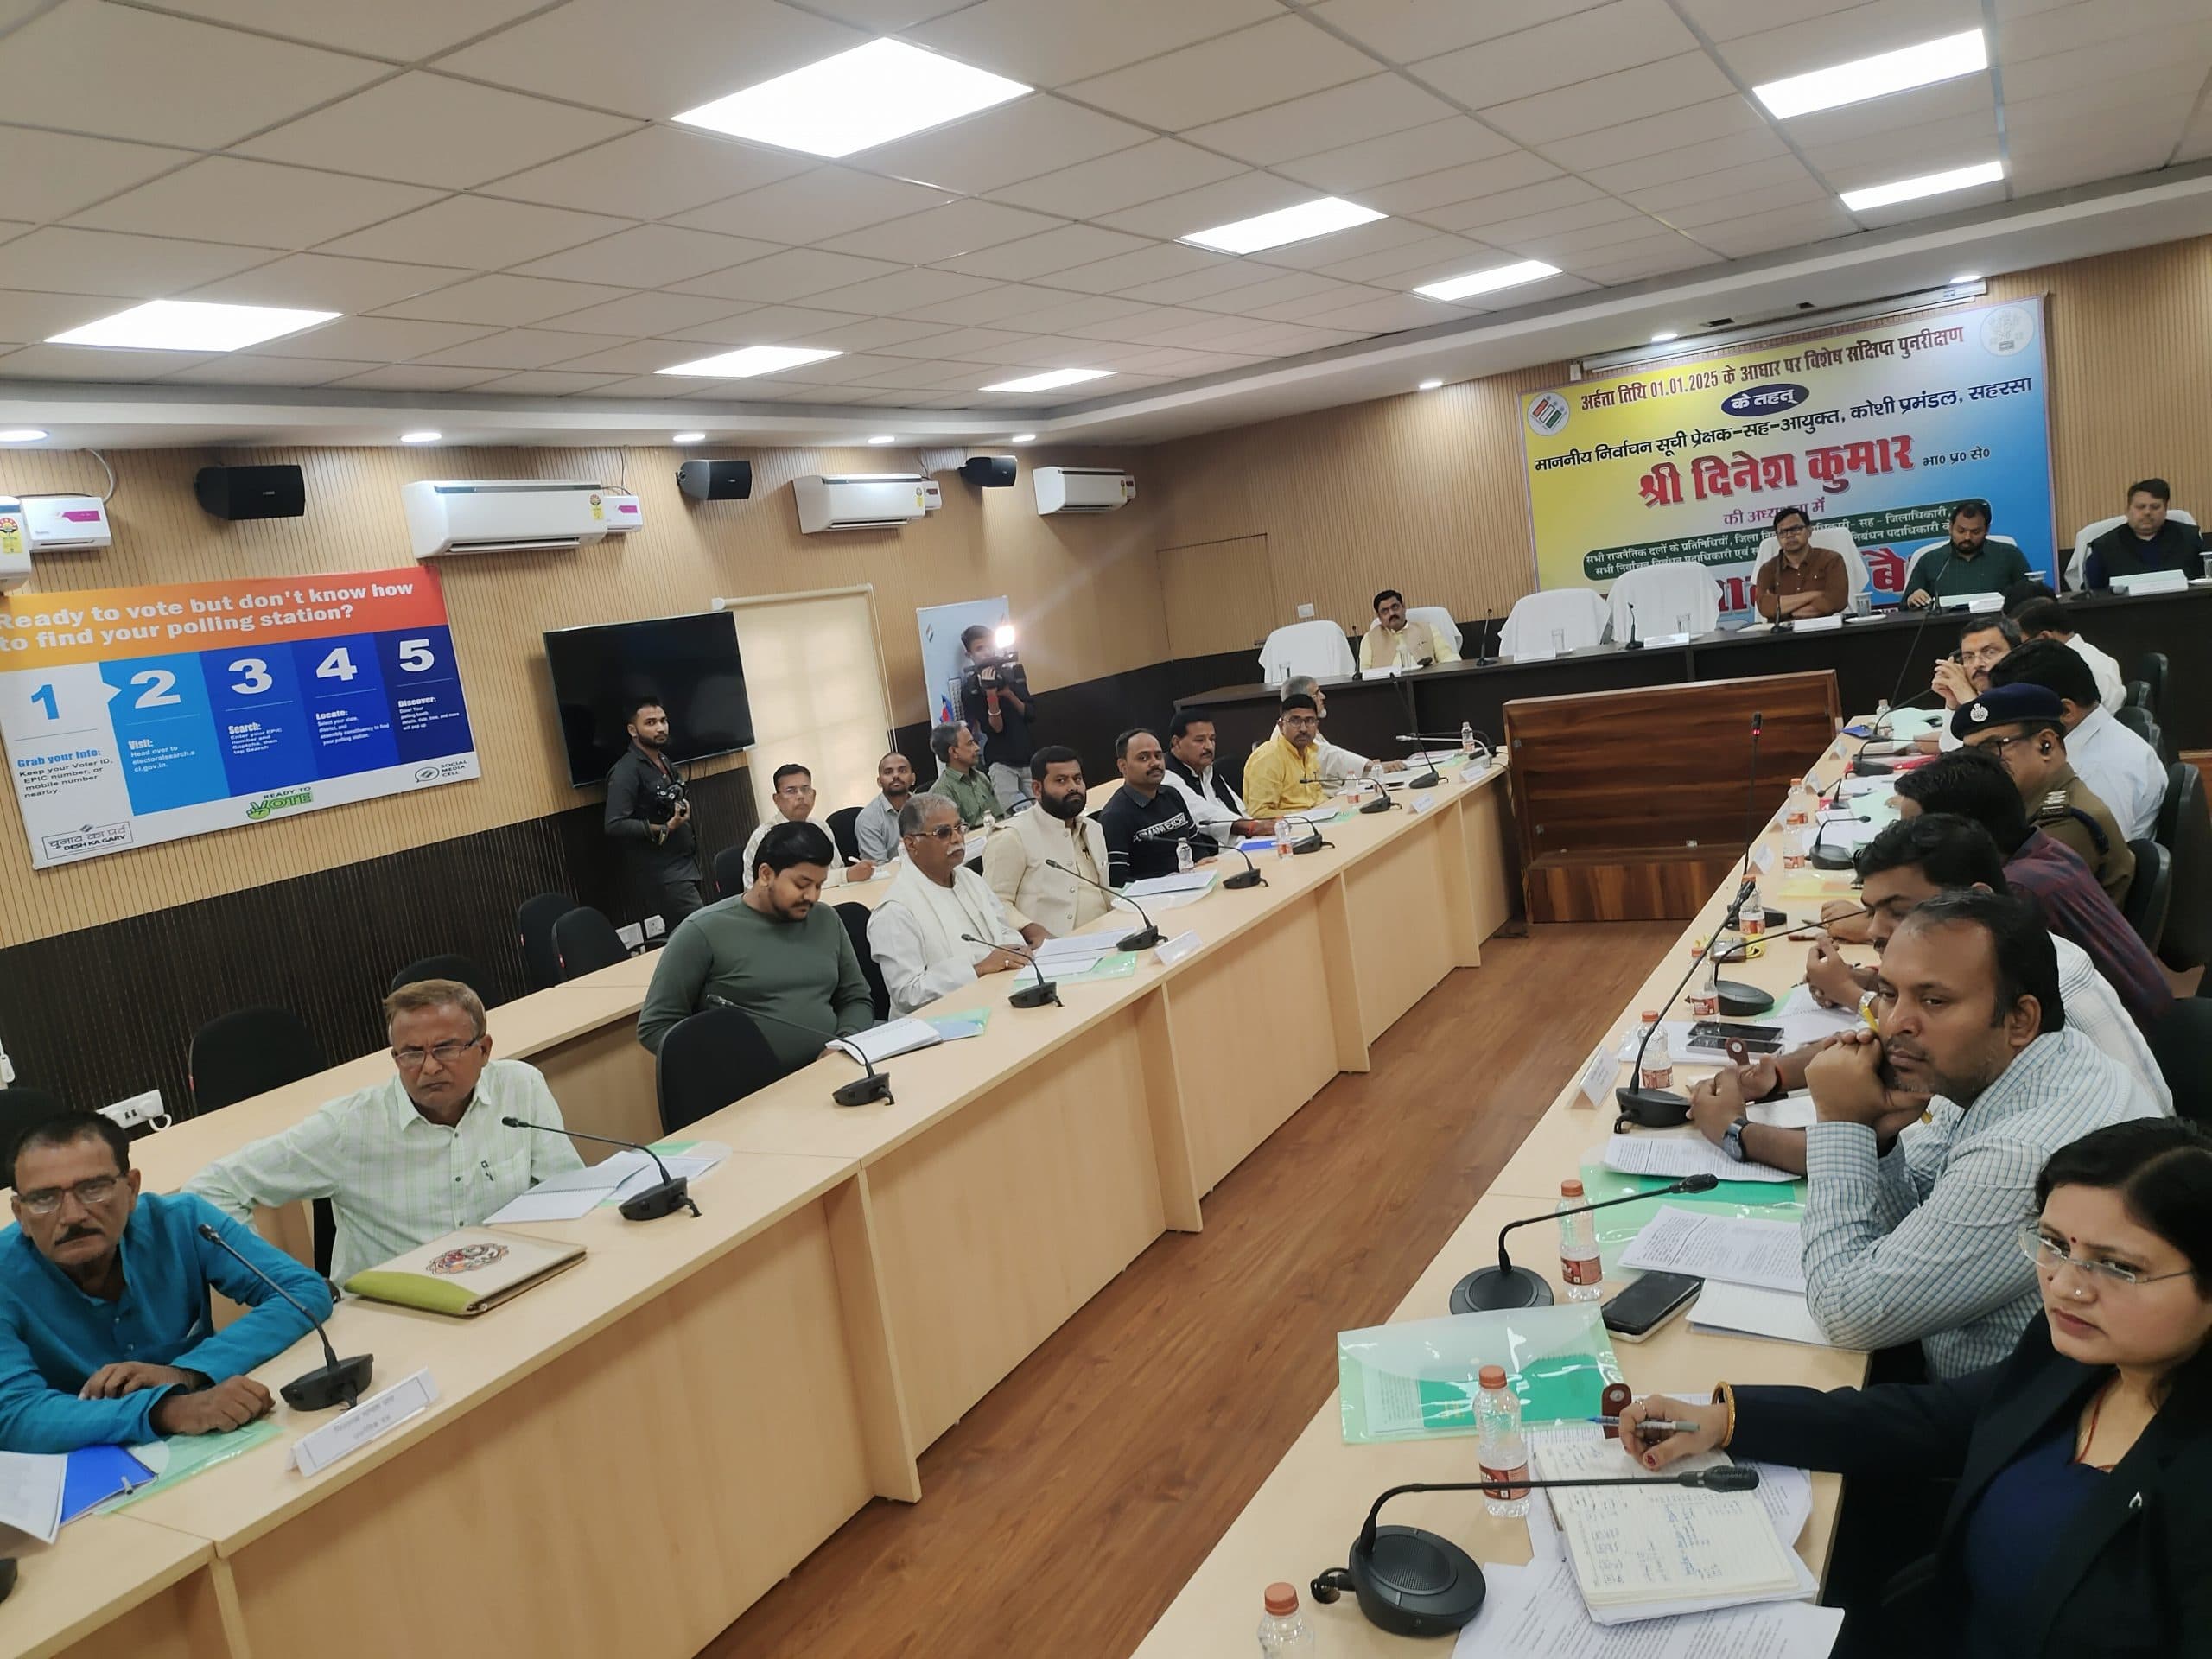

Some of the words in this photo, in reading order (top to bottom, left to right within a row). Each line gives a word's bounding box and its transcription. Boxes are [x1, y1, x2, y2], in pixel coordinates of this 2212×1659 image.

[1618, 382, 1647, 404] तिथि
[1650, 372, 1719, 397] 01.01.2025
[1720, 365, 1736, 385] के
[1783, 356, 1802, 373] पर
[1803, 347, 1843, 370] विशेष
[1898, 327, 1964, 359] पुनरीक्षण
[1731, 393, 1750, 410] के
[1535, 448, 1592, 472] माननीय
[1595, 440, 1652, 462] निर्वाचन
[1656, 430, 1688, 457] सूची
[1850, 395, 1895, 419] कोशी
[1898, 390, 1963, 415] प्रमंडल,
[1968, 378, 2032, 401] सहरसा
[1638, 461, 1684, 508] श्री
[1690, 449, 1799, 500] दिनेश
[1805, 434, 1915, 494] कुमार
[1724, 508, 1744, 525] की
[1811, 496, 1826, 512] में
[1586, 551, 1605, 564] सभी
[1606, 547, 1647, 561] राजनैतिक
[1648, 543, 1668, 557] दलों
[1669, 541, 1679, 552] के
[1734, 532, 1759, 545] जिला
[1858, 518, 1875, 528] सह
[1594, 563, 1615, 576] सभी
[1734, 545, 1750, 560] एवं
[1885, 520, 1940, 537] पदाधिकारी
[0, 608, 83, 630] Ready
[91, 607, 120, 622] to
[126, 601, 183, 620] vote
[189, 595, 234, 614] but
[238, 589, 305, 610] don't
[308, 588, 366, 604] know
[371, 582, 413, 598] how
[0, 636, 29, 652] to
[35, 628, 93, 648] find
[100, 624, 160, 645] your
[167, 614, 256, 639] polling
[259, 604, 353, 627] station?
[315, 647, 358, 682] 4
[398, 638, 435, 673] 5
[228, 658, 273, 695] 3
[130, 669, 181, 709] 2
[30, 683, 60, 721] 1
[398, 696, 436, 708] Discover:
[315, 710, 349, 721] Locate:
[228, 721, 262, 734] Search:
[128, 739, 154, 750] Visit:
[131, 749, 151, 758] Head
[17, 756, 45, 768] Grab
[48, 753, 73, 764] your
[75, 748, 101, 760] Info:
[19, 769, 45, 778] Keep
[48, 765, 69, 774] your
[72, 760, 98, 769] Voter
[441, 760, 467, 768] SOCIAL
[23, 774, 48, 784] EPIC
[25, 780, 59, 791] mobile
[61, 774, 98, 785] number
[248, 792, 312, 817] VOTE
[263, 789, 296, 800] READY
[48, 835, 83, 849] चुनाव
[87, 831, 105, 840] का
[102, 835, 126, 843] GARV
